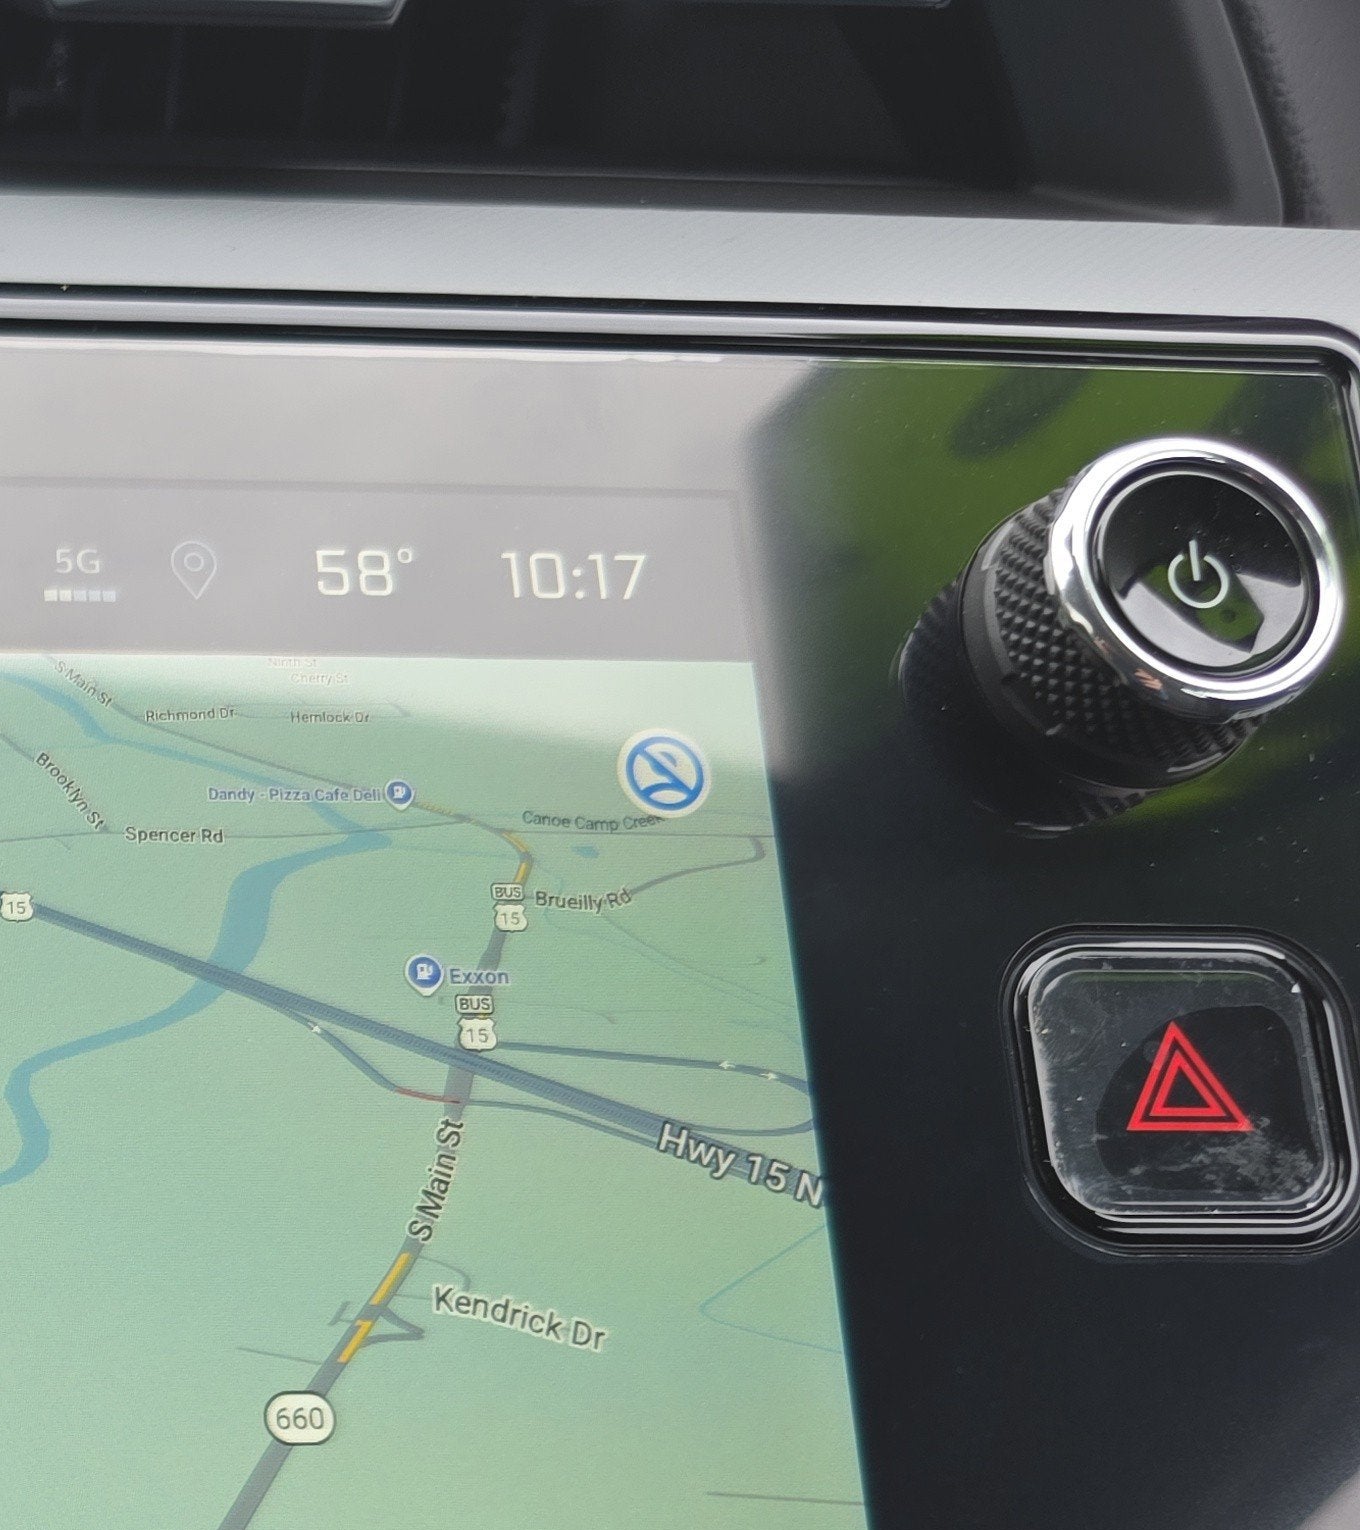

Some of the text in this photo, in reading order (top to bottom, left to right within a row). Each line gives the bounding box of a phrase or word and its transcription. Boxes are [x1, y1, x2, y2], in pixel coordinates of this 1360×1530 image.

[55, 548, 101, 575] 5G
[315, 546, 414, 598] 58°
[500, 550, 648, 600] 10:17
[64, 668, 97, 697] Main
[100, 691, 113, 708] St
[146, 706, 235, 723] Richmond Dr
[290, 710, 370, 723] Hemlock Dr
[35, 751, 106, 831] Brooklyn St
[209, 786, 256, 804] Dandy
[269, 788, 311, 802] Pizza
[314, 787, 349, 802] Cafe
[353, 787, 381, 802] Deli
[521, 810, 571, 829] Canoe
[574, 812, 619, 832] Camp
[125, 826, 225, 844] Spencer Rd
[494, 886, 521, 899] BUS
[534, 888, 632, 914] Brueilly Rd
[7, 901, 27, 915] 15
[500, 911, 521, 926] 15
[449, 968, 510, 985] Exxon
[459, 997, 491, 1011] BUS
[467, 1028, 489, 1044] 15
[657, 1122, 826, 1207] Hwy 15 N
[408, 1118, 464, 1242] S Main St
[433, 1286, 607, 1351] Kendrick Dr
[276, 1406, 325, 1430] 660
